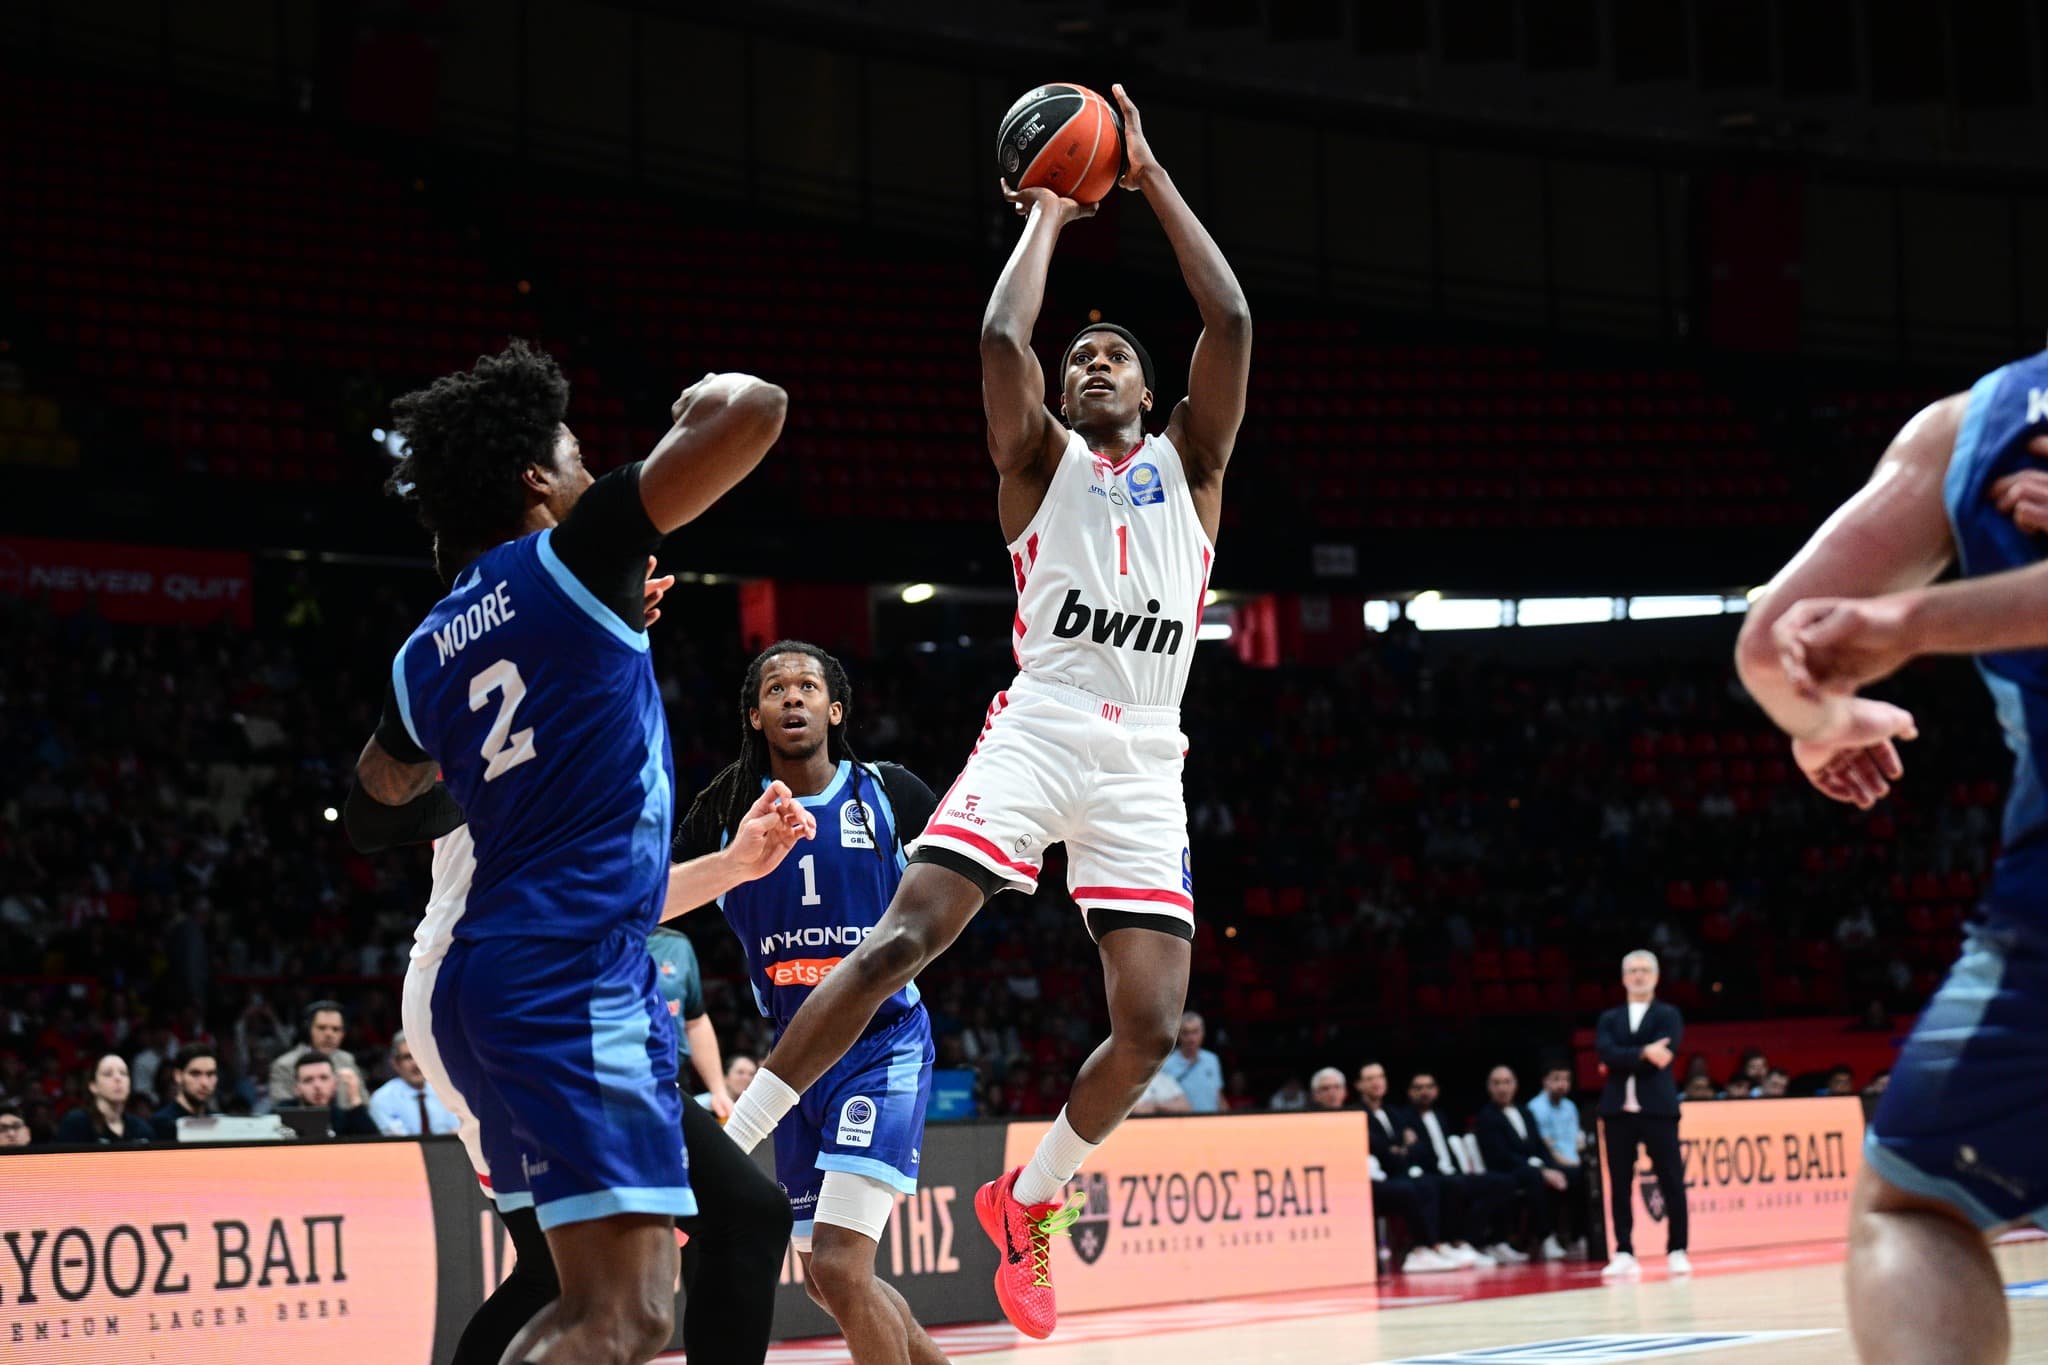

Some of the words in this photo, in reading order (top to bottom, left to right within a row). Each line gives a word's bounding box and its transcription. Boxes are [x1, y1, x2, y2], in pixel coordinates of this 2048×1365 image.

[1115, 525, 1128, 575] 1
[28, 563, 153, 594] NEVER
[163, 574, 246, 602] QUIT
[432, 579, 516, 667] MOORE
[1052, 589, 1184, 655] bwin
[468, 658, 537, 783] 2
[798, 854, 821, 906] 1
[1784, 1131, 1847, 1182] ΒΑΠ
[1119, 1171, 1241, 1228] ΖΥΘΟΣ
[1253, 1165, 1329, 1218] ΒΑΠ
[0, 1223, 190, 1306] ΥΘΟΣ
[213, 1214, 348, 1289] ΒΑΠ
[149, 1310, 248, 1331] LAGER
[277, 1299, 351, 1321] BEER
